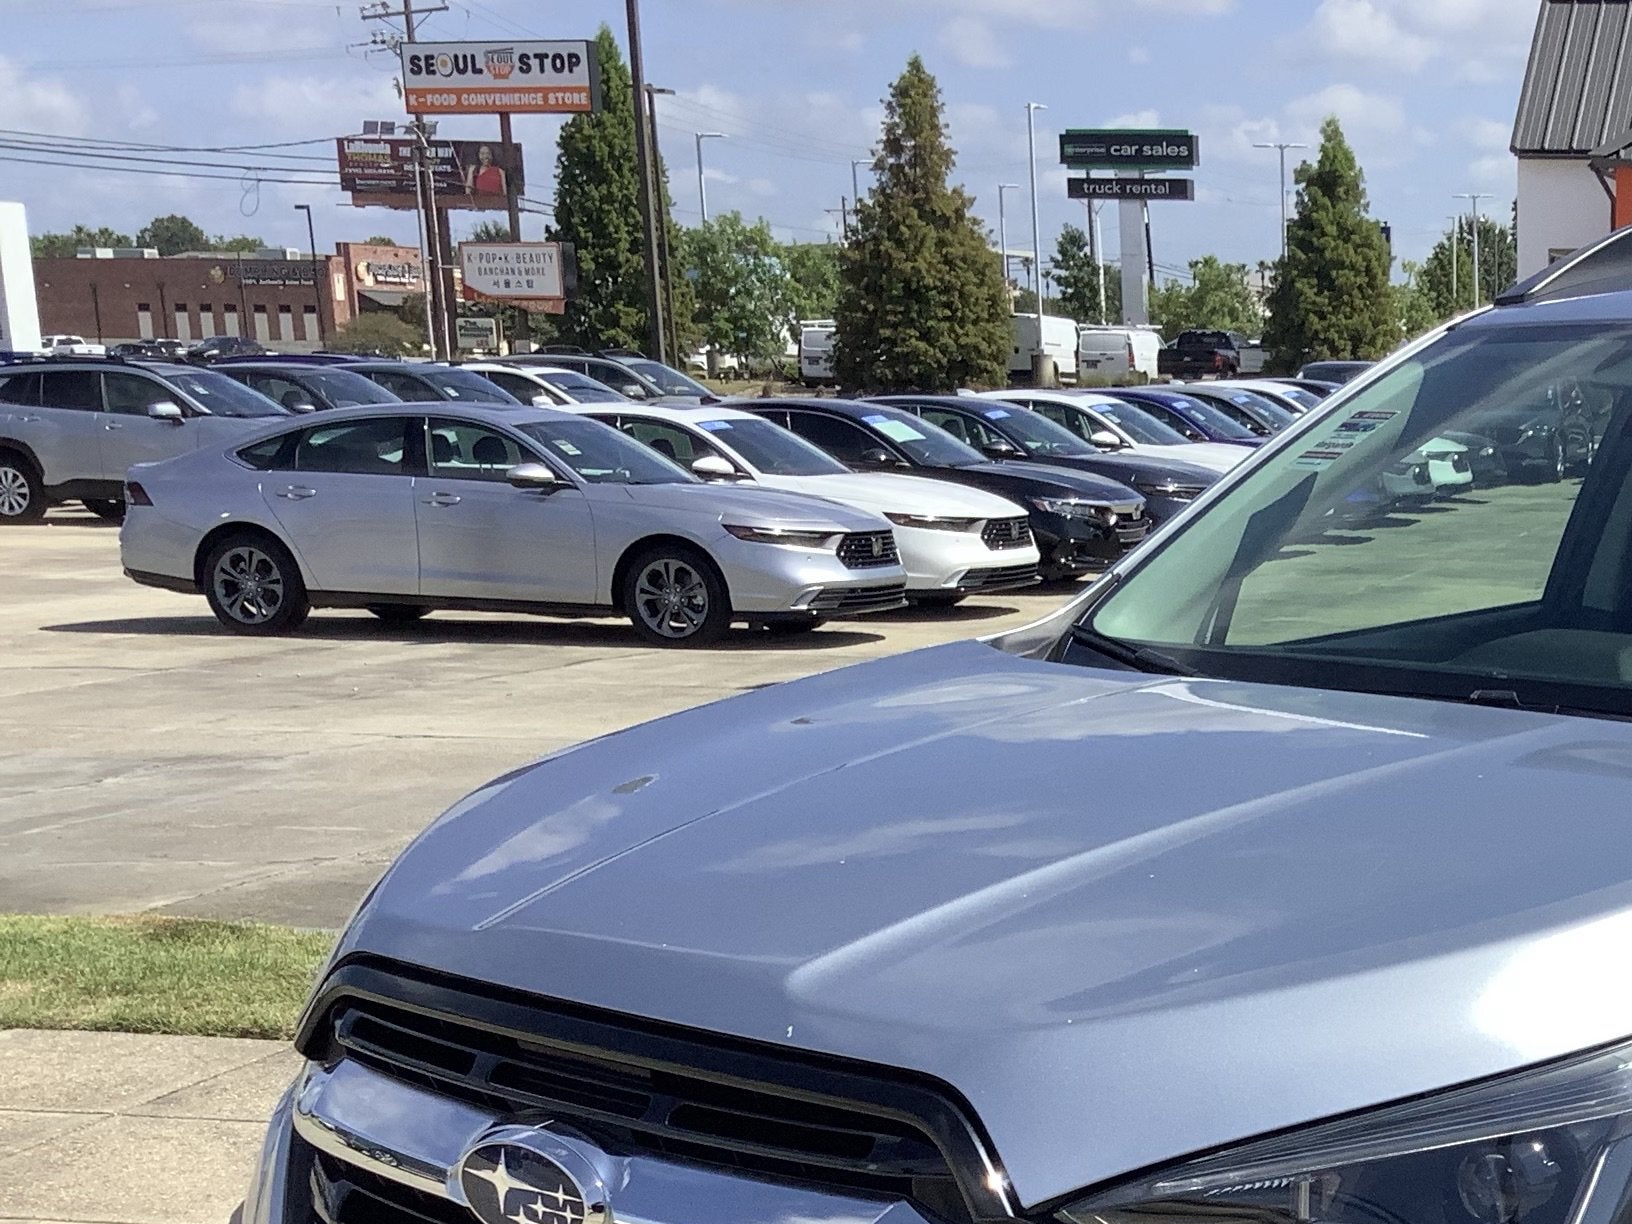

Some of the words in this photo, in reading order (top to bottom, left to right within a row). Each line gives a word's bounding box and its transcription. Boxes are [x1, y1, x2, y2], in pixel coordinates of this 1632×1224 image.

[518, 52, 581, 74] STOP
[408, 94, 457, 106] K-FOOD
[461, 93, 545, 106] CONVENIENCE
[548, 92, 588, 105] STORE
[1110, 144, 1139, 156] car
[1142, 141, 1189, 157] sales
[1082, 181, 1121, 194] truck
[1126, 182, 1170, 195] rental
